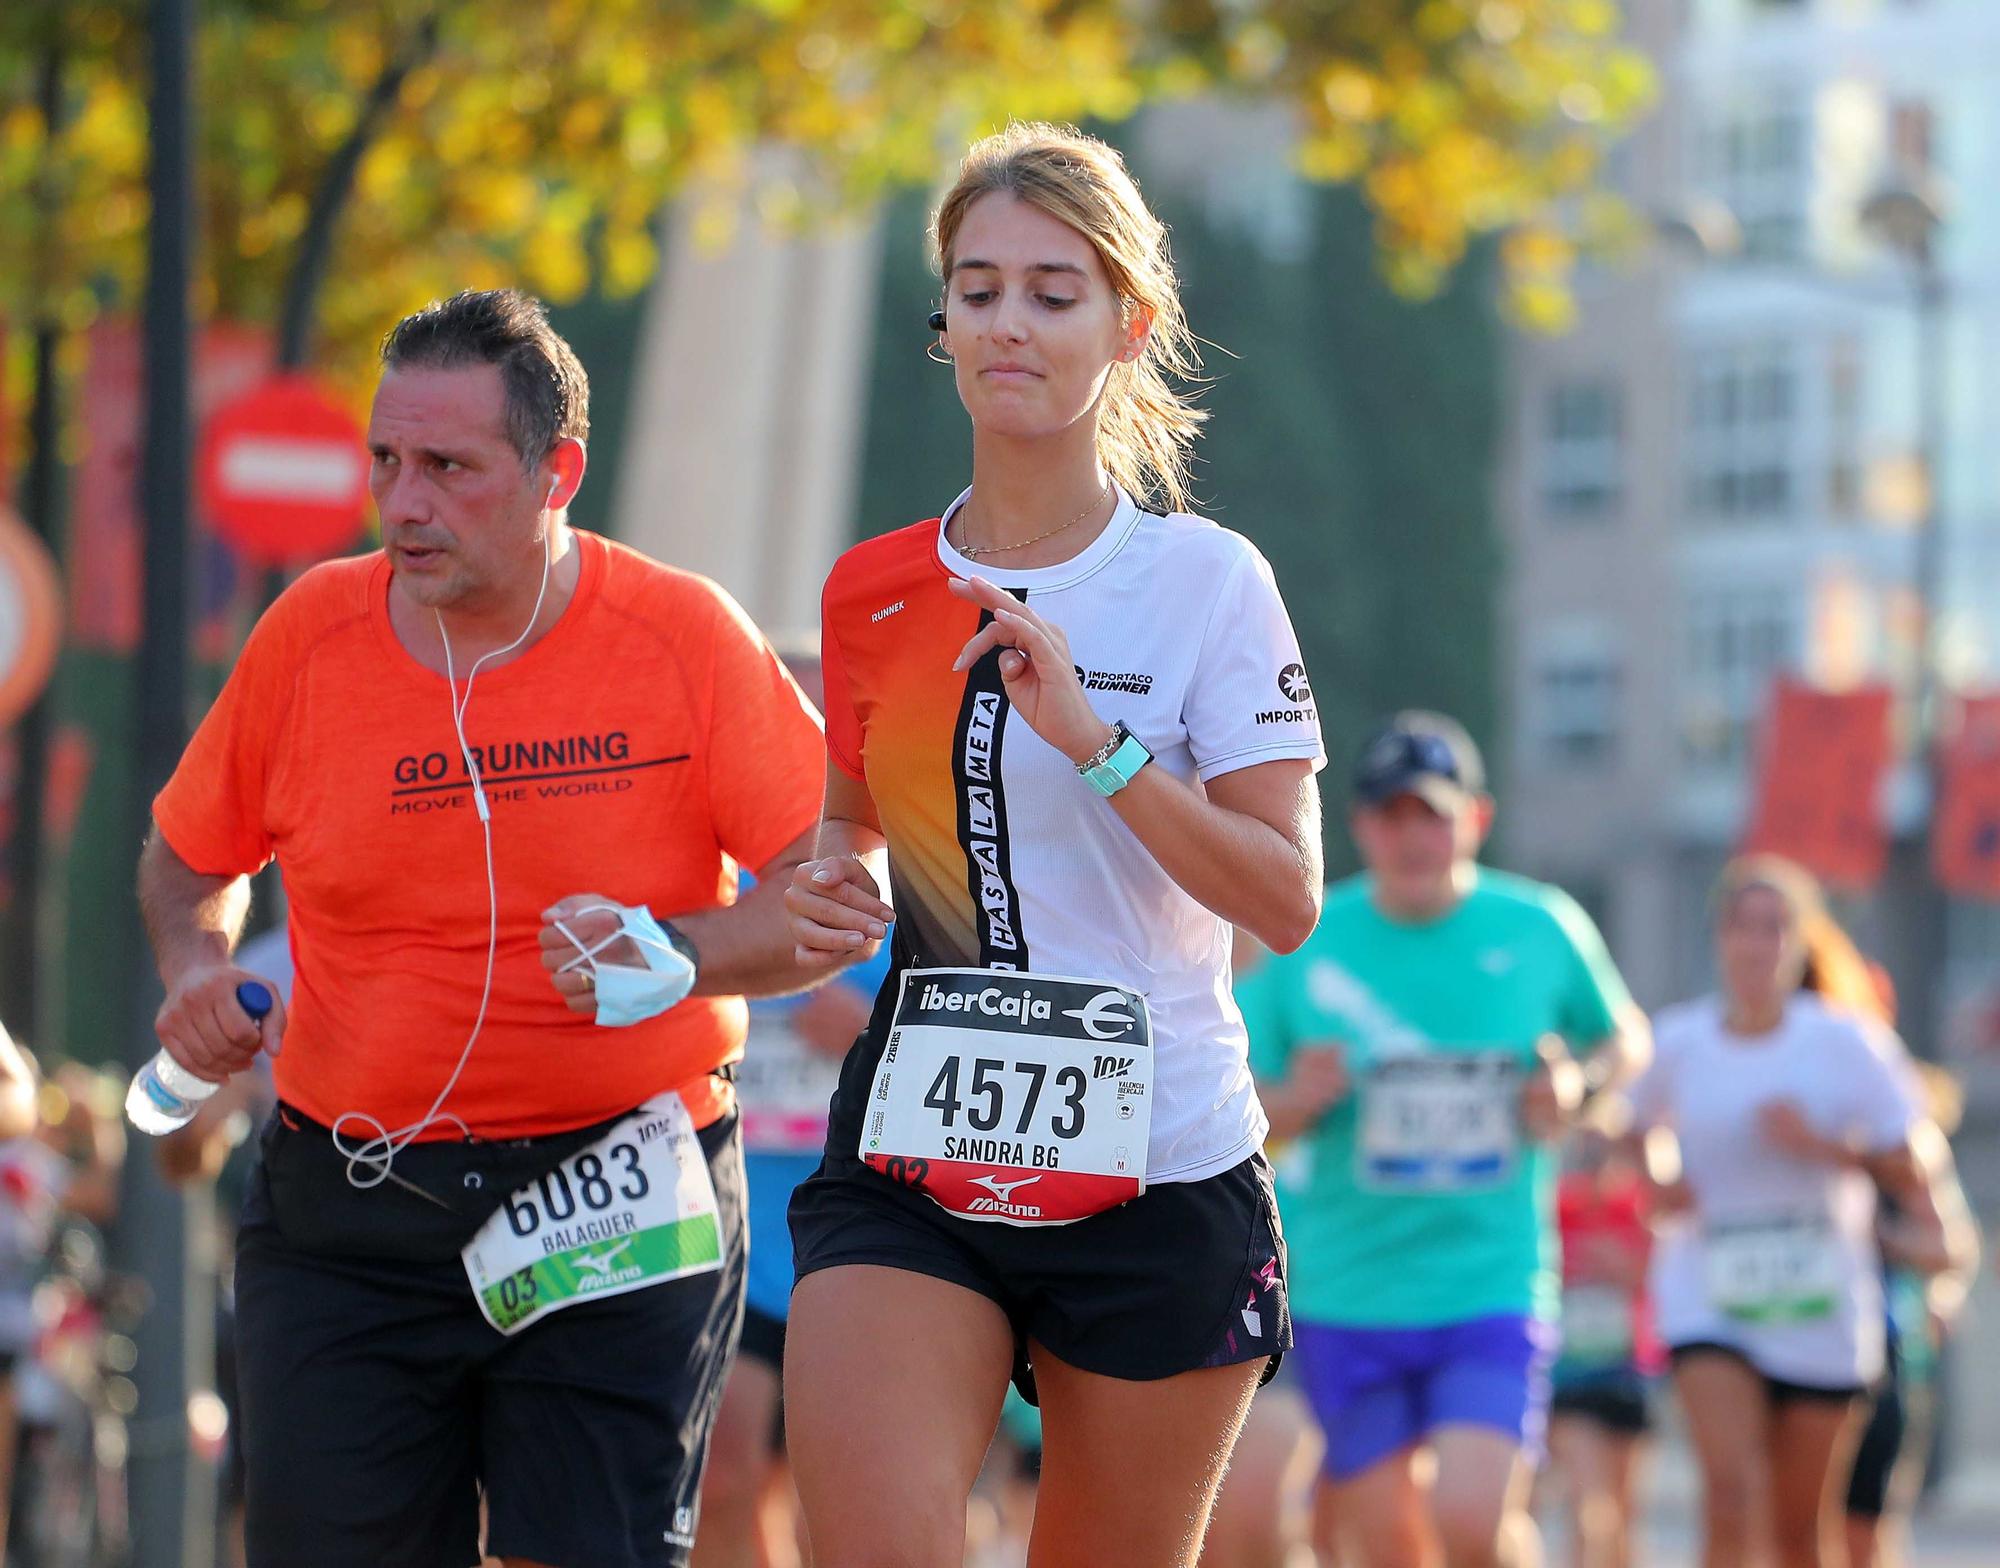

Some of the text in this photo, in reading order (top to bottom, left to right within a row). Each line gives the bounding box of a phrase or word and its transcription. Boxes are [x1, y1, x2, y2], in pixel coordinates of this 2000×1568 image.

[871, 600, 905, 623] RUNNEK
[1085, 679, 1151, 695] RUNNER
[1088, 670, 1153, 684] IMPORTACO
[1255, 709, 1316, 725] IMPORT
[968, 697, 997, 780] META
[394, 732, 629, 784] GO RUNNING
[391, 796, 467, 815] MOVE
[537, 779, 633, 798] WORLD
[972, 791, 993, 829] LA
[974, 846, 1014, 946] HASTA
[919, 983, 1052, 1026] iberCaja
[885, 1030, 902, 1065] 226ERS
[1092, 1055, 1135, 1080] 10K
[923, 1055, 1088, 1140] 4573
[1117, 1081, 1145, 1090] VALENCIA
[943, 1136, 1060, 1169] SANDRA BG
[1117, 1160, 1125, 1171] M
[503, 1143, 649, 1236] 6083
[886, 1157, 929, 1187] 02
[542, 1210, 638, 1254] BALAGUER
[500, 1265, 538, 1312] 03
